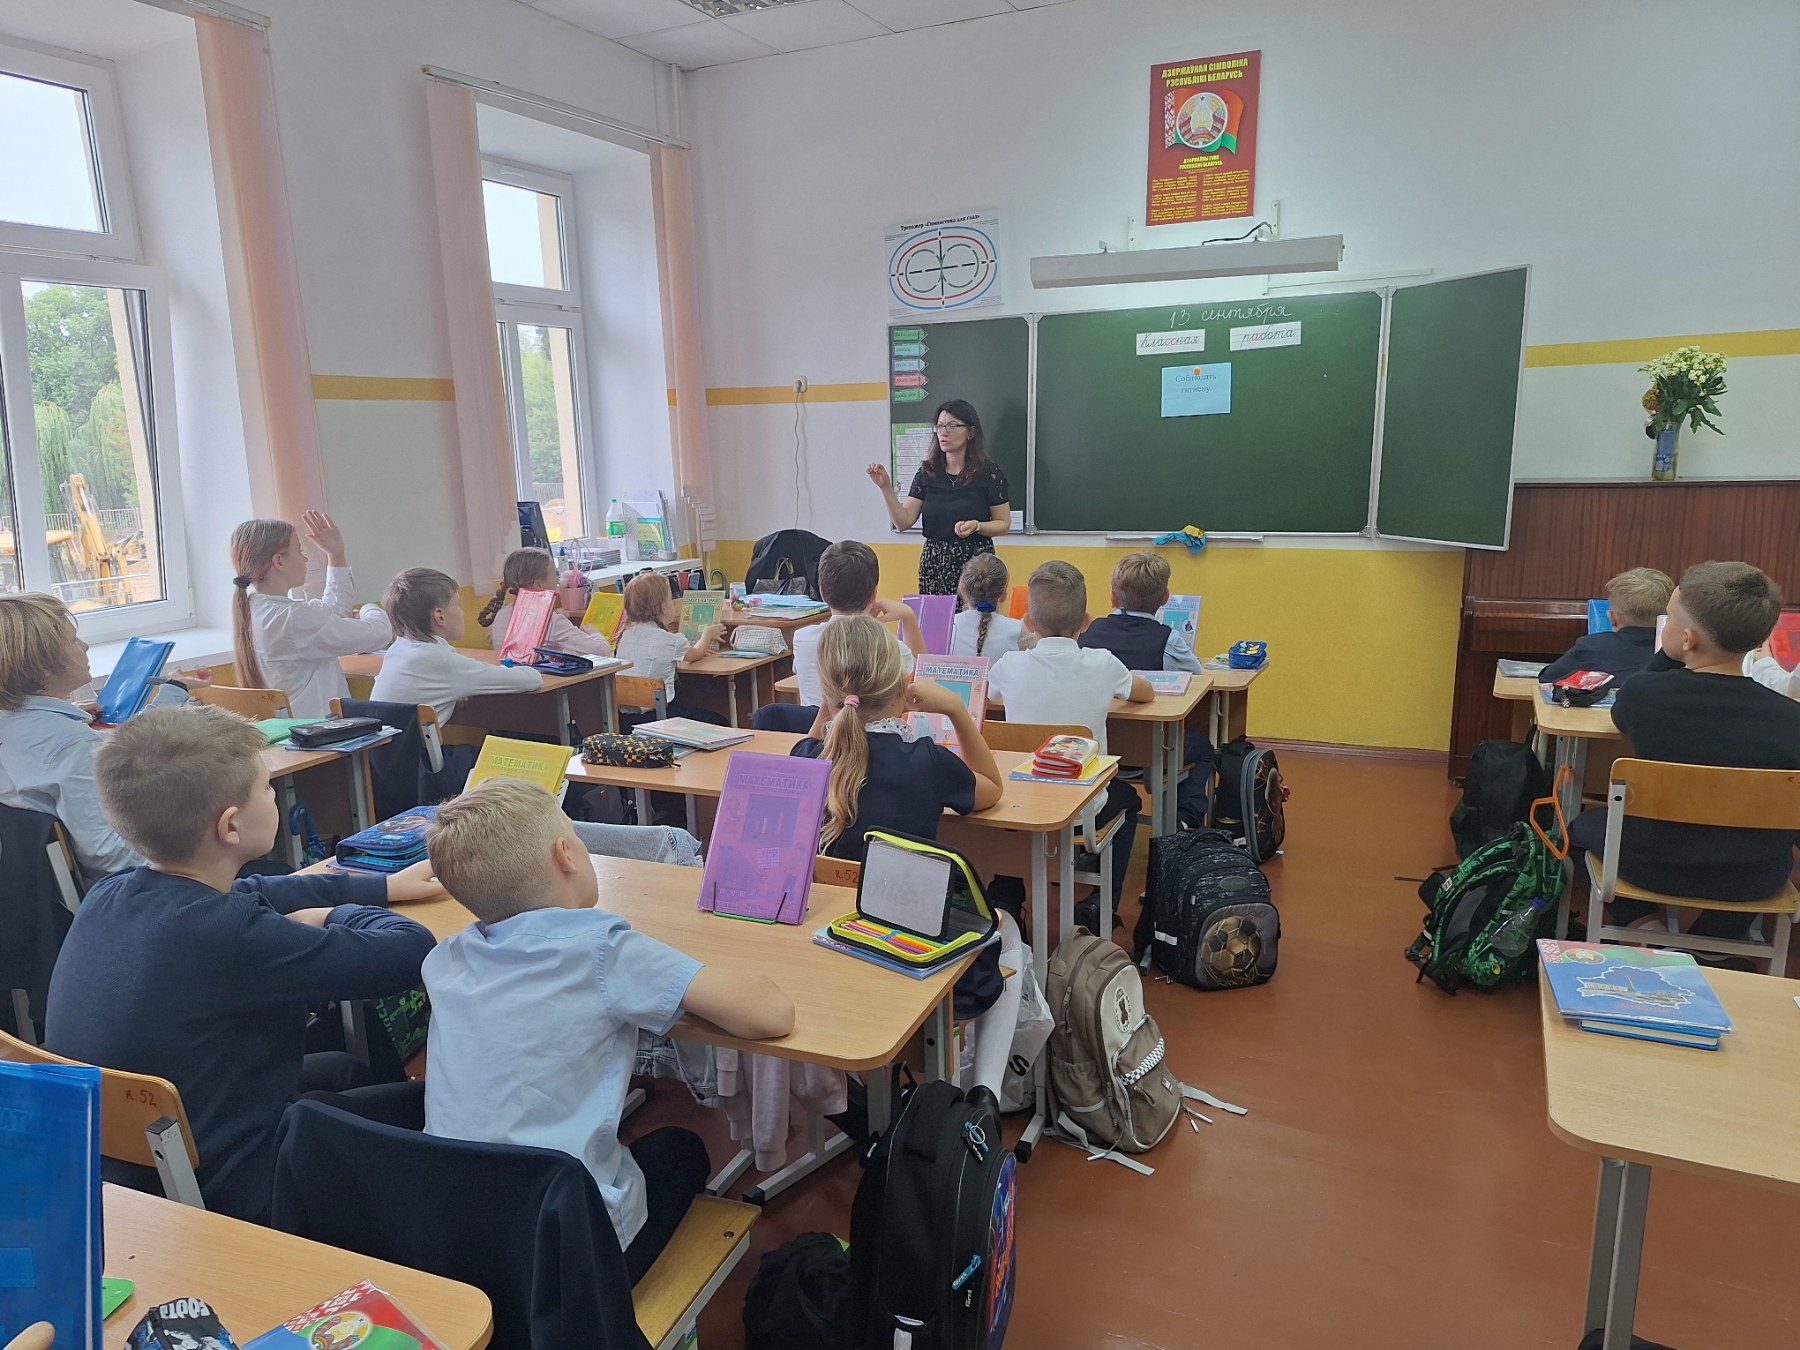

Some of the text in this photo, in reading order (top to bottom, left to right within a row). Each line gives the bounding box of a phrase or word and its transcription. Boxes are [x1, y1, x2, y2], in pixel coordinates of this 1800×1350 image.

[1161, 58, 1248, 79] ДЗЯРЖАЎНАЯ СІМВОЛІКА
[1166, 70, 1243, 87] РЭСПУБЛІКІ БЕЛАРУСЬ
[1169, 302, 1293, 329] 13 сентября
[1140, 325, 1295, 349] Классная работа
[1175, 373, 1217, 383] Соблюдать
[1181, 385, 1211, 394] гигиену
[926, 665, 980, 677] МАТЕМАТИКА
[492, 755, 549, 771] МАТЕМАТИКА
[739, 773, 809, 790] МАТЕМАТИКА
